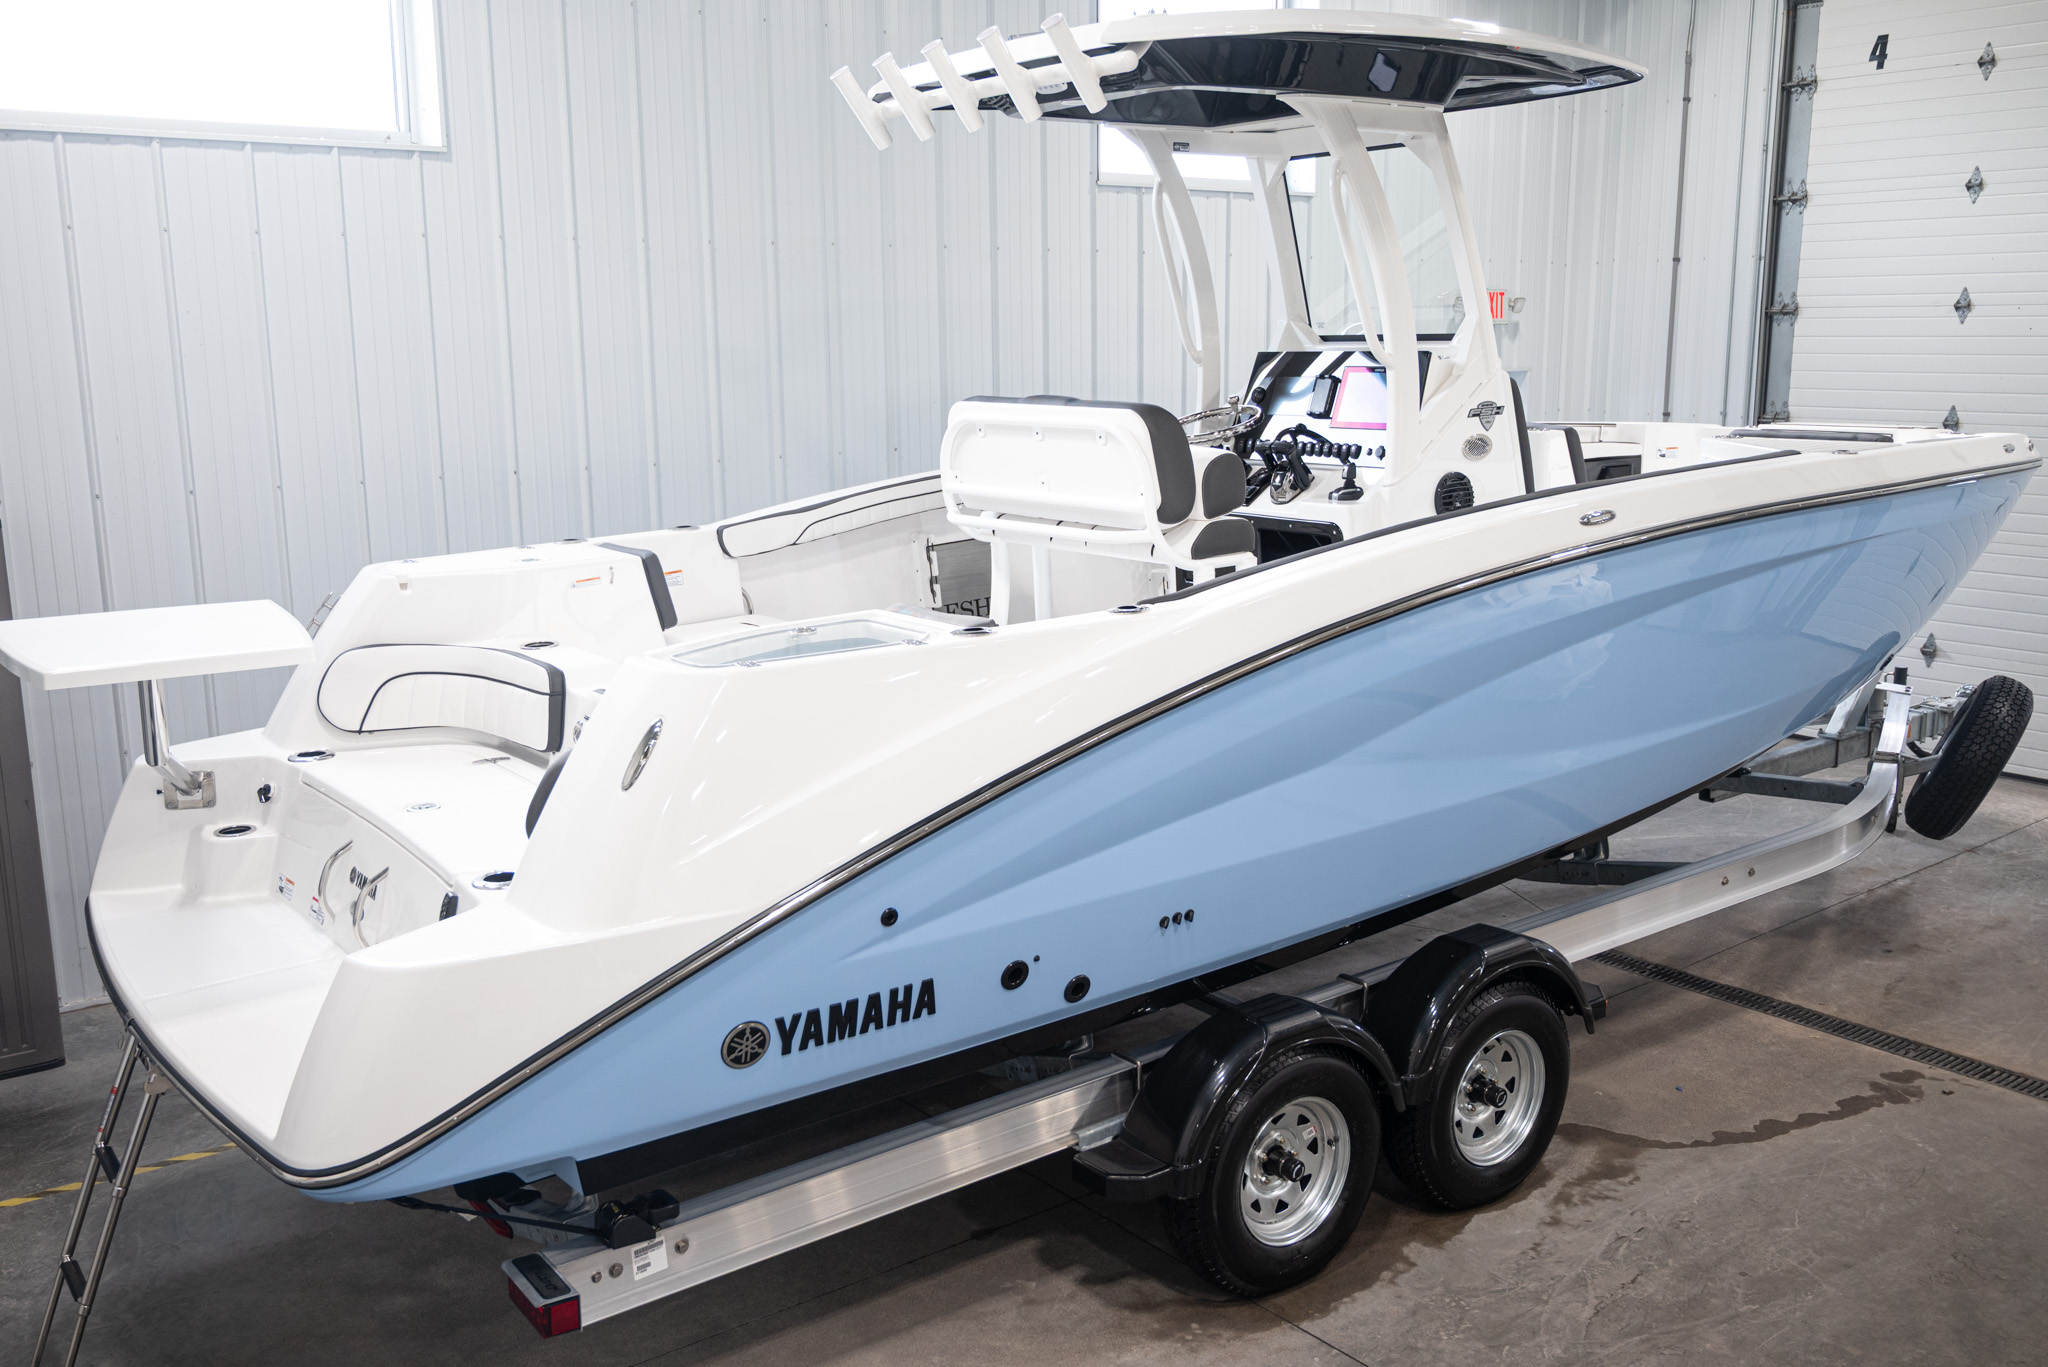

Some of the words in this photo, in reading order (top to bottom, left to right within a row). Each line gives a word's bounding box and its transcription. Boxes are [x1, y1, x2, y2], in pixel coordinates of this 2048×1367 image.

[1869, 34, 1889, 70] 4
[1487, 292, 1505, 319] XIT
[1467, 406, 1505, 418] FSH
[774, 977, 937, 1056] YAMAHA
